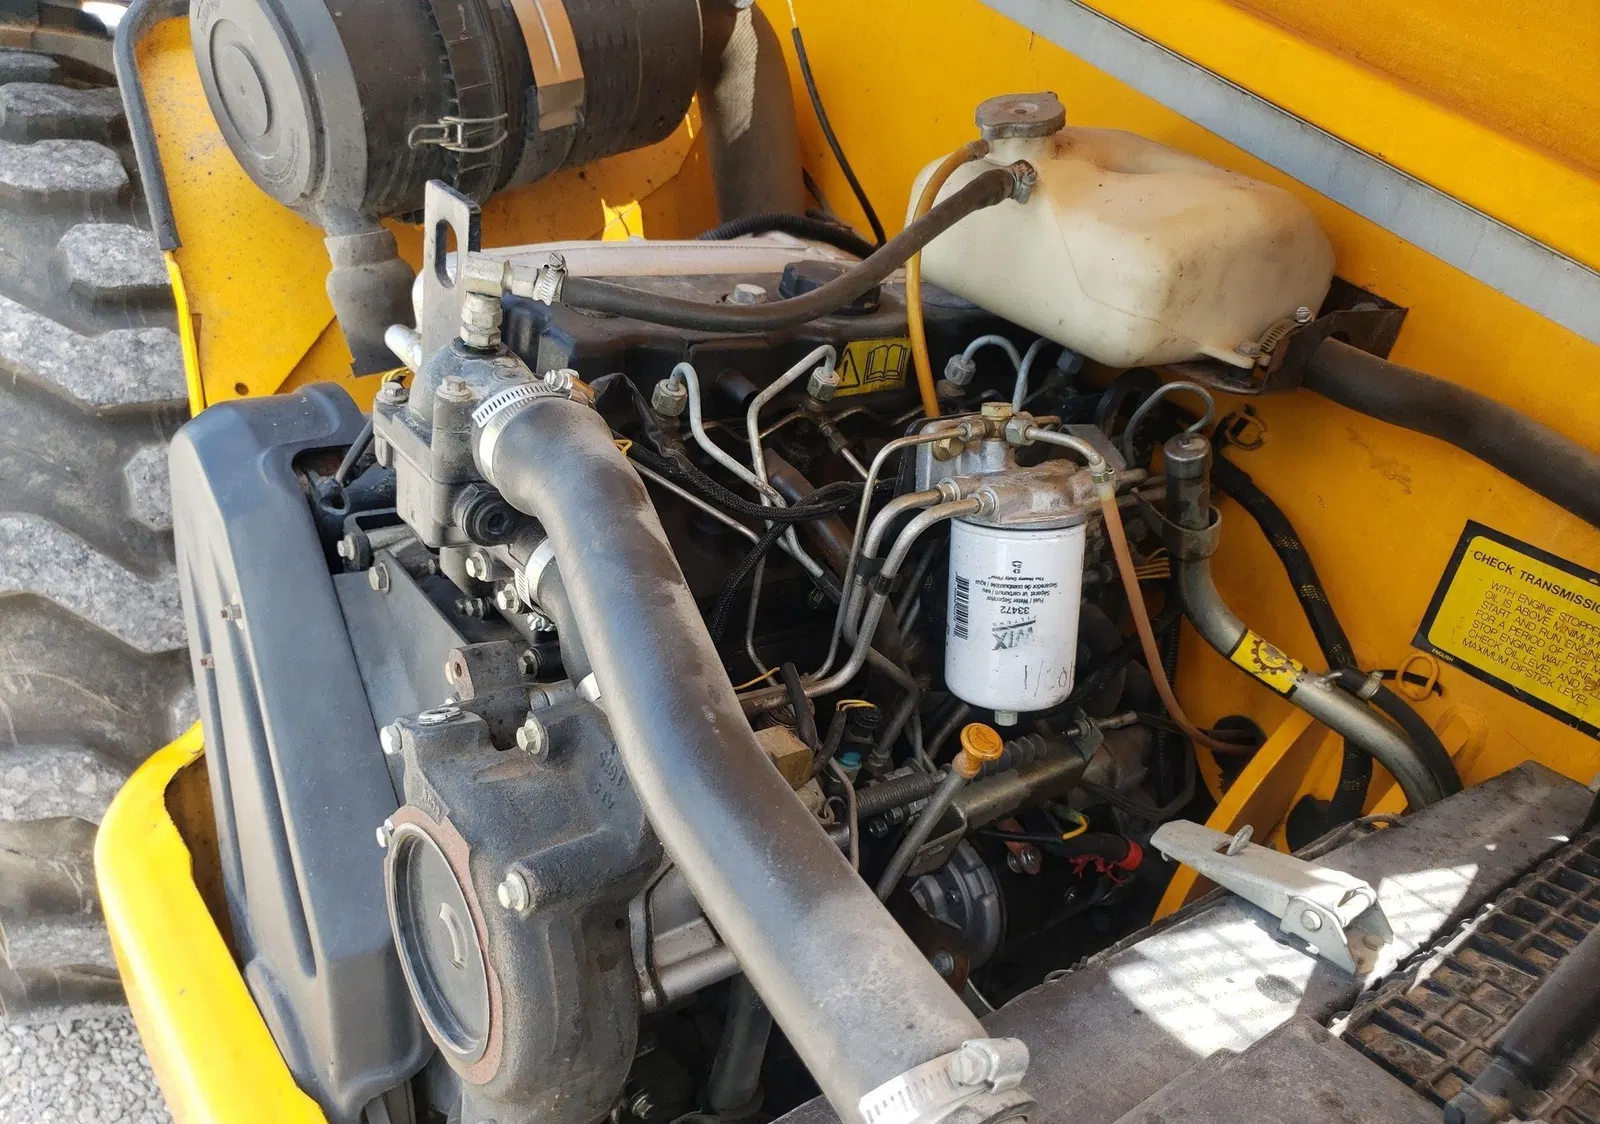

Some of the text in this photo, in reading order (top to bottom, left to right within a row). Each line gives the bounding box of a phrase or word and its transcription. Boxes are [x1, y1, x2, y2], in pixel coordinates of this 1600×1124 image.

[1473, 550, 1515, 575] CHECK
[1000, 605, 1030, 615] 33472
[1481, 600, 1512, 619] START
[1514, 616, 1538, 632] AND
[1539, 626, 1562, 643] RUN
[1485, 590, 1498, 603] OIL
[1502, 598, 1512, 608] IS
[1515, 605, 1551, 626] ABOVE
[1492, 581, 1600, 638] WITH ENGINE STOPPE
[991, 626, 1035, 651] WIX
[1468, 629, 1501, 651] CHECK
[1504, 646, 1519, 660] OIL
[1522, 655, 1553, 677] LEVEL
[1556, 672, 1580, 688] AND
[1472, 619, 1498, 636] STOP
[1542, 651, 1567, 669] WAIT
[1569, 666, 1593, 681] ONE
[1475, 609, 1588, 669] FOR A PERIOD OF FIVE
[1462, 637, 1589, 706] MAXIMUM DIPSTICK LEVEL
